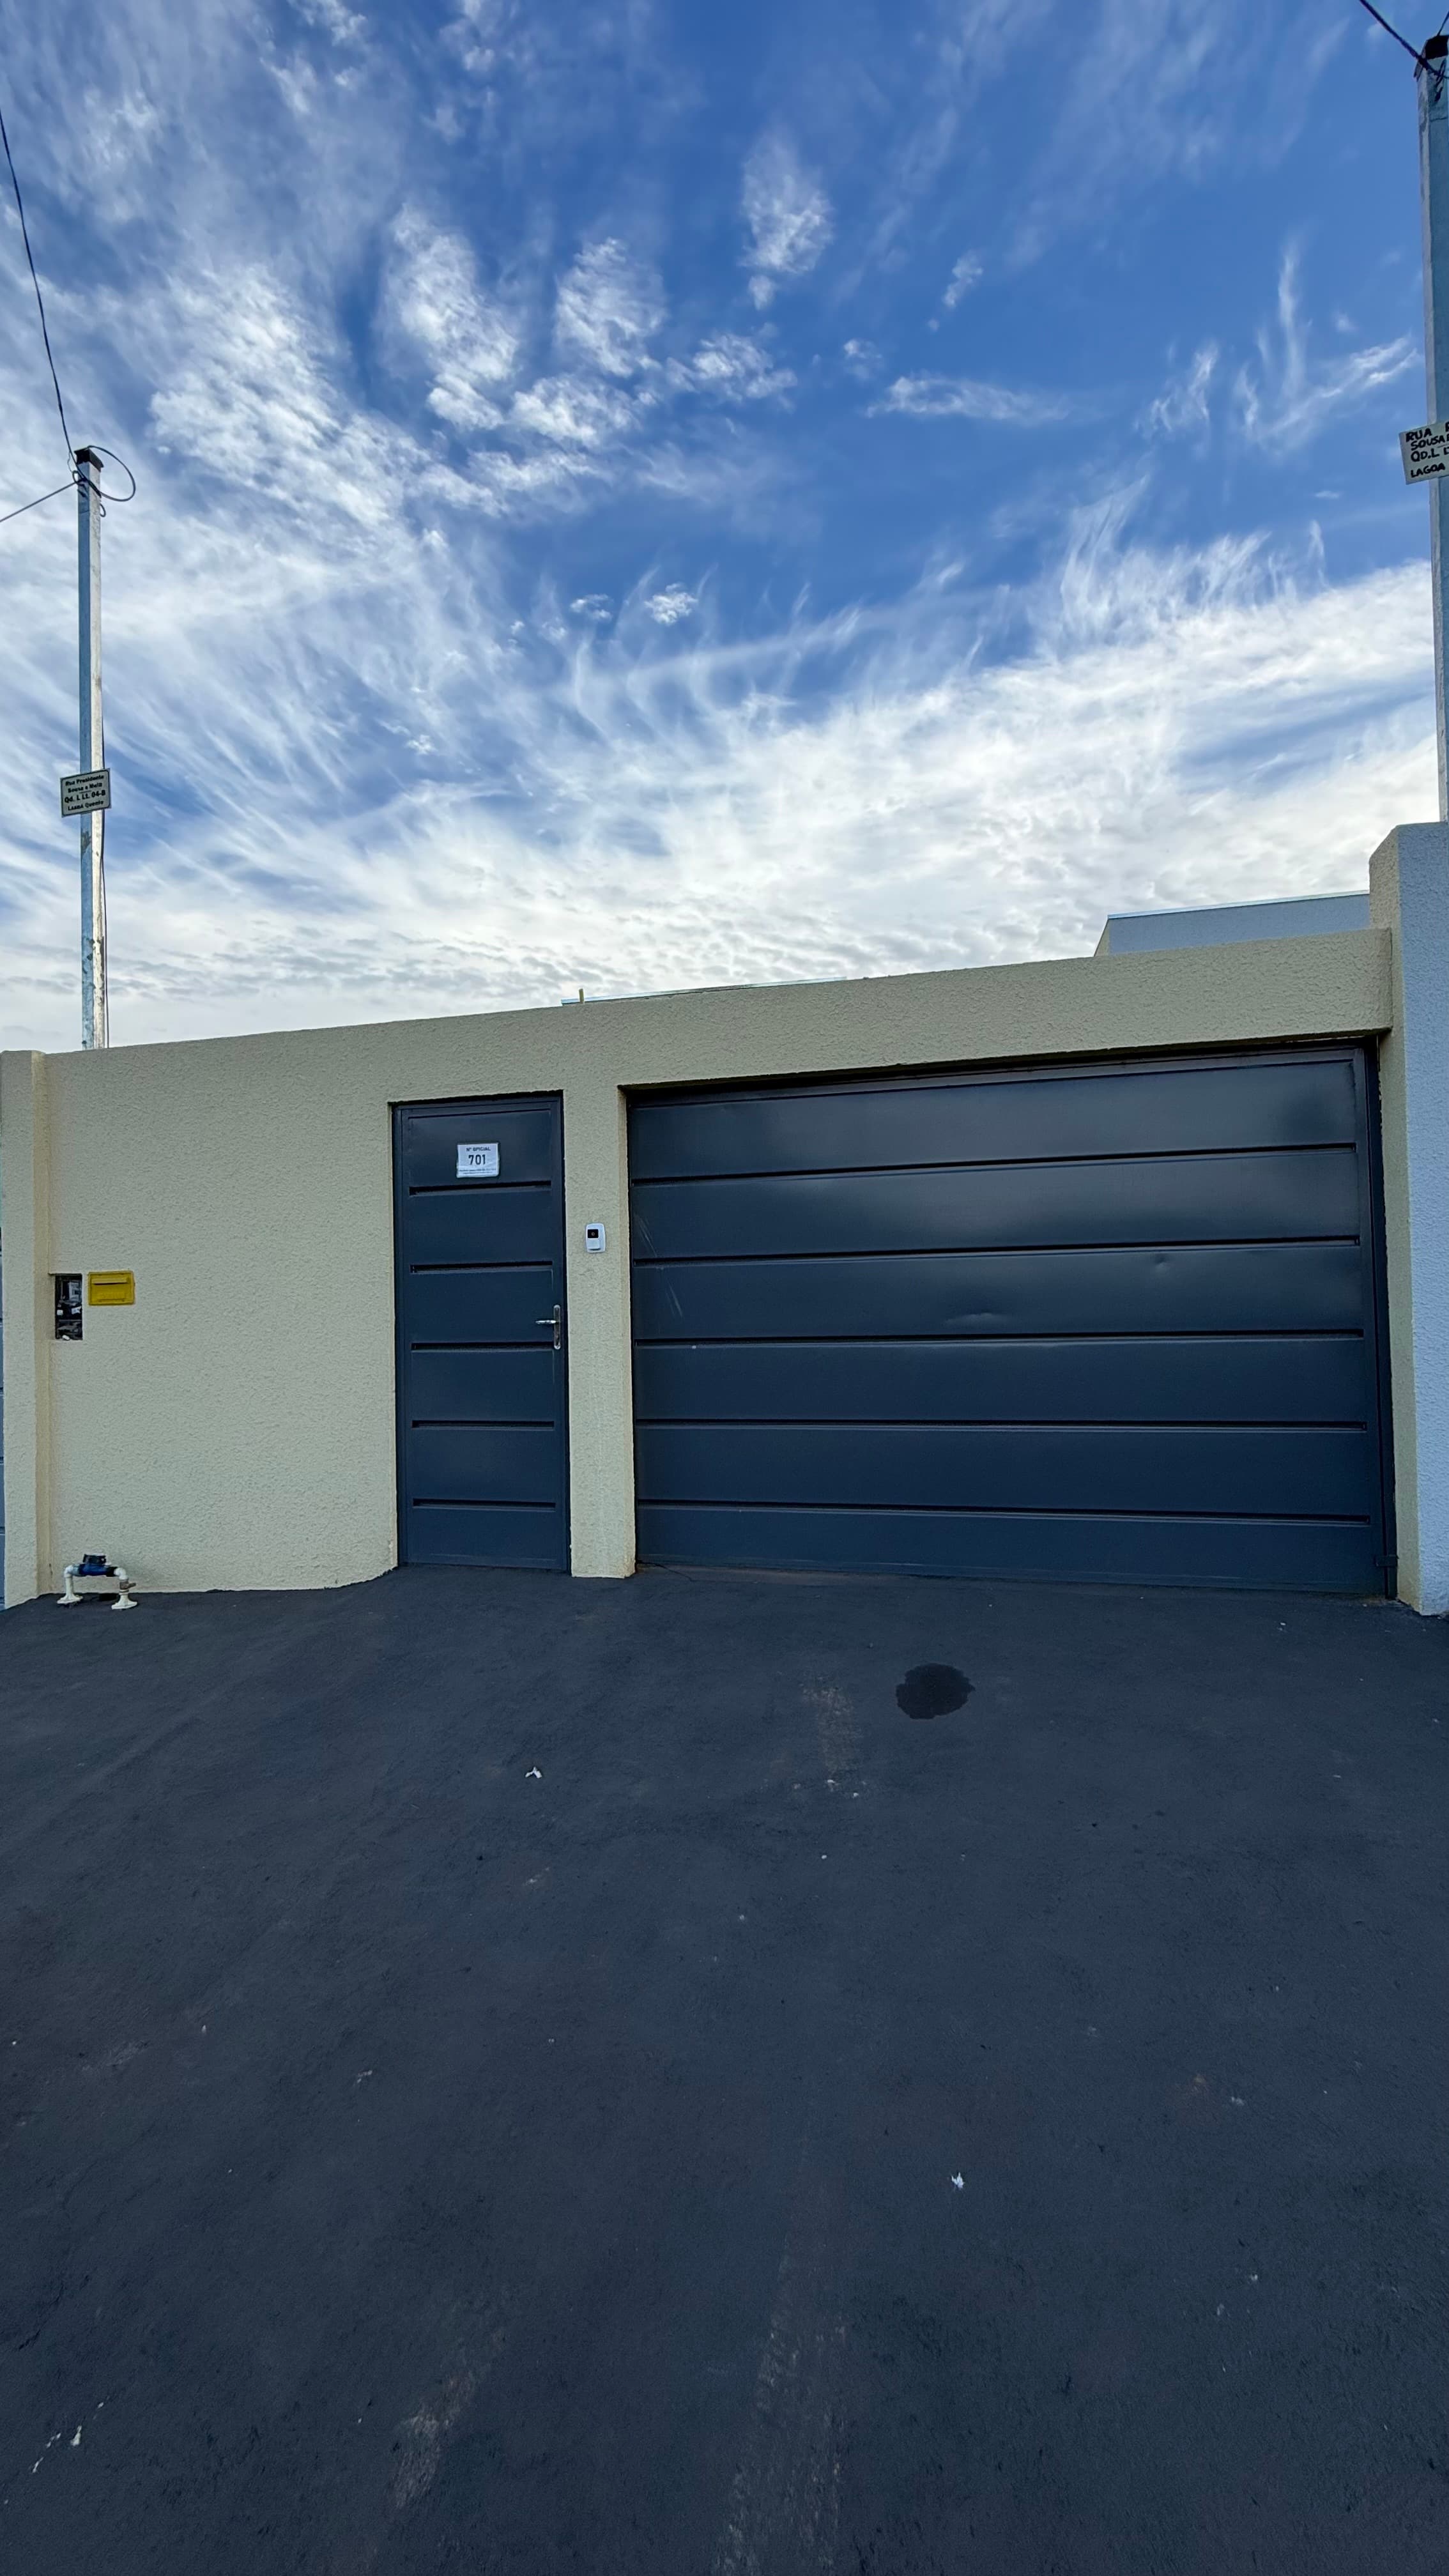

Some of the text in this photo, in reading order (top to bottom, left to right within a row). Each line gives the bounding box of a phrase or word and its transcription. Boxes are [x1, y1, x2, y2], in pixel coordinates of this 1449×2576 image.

[1406, 428, 1432, 442] RUA
[1411, 435, 1445, 451] SOUSA
[1411, 463, 1445, 478] LAGOA
[468, 1154, 486, 1165] 701
